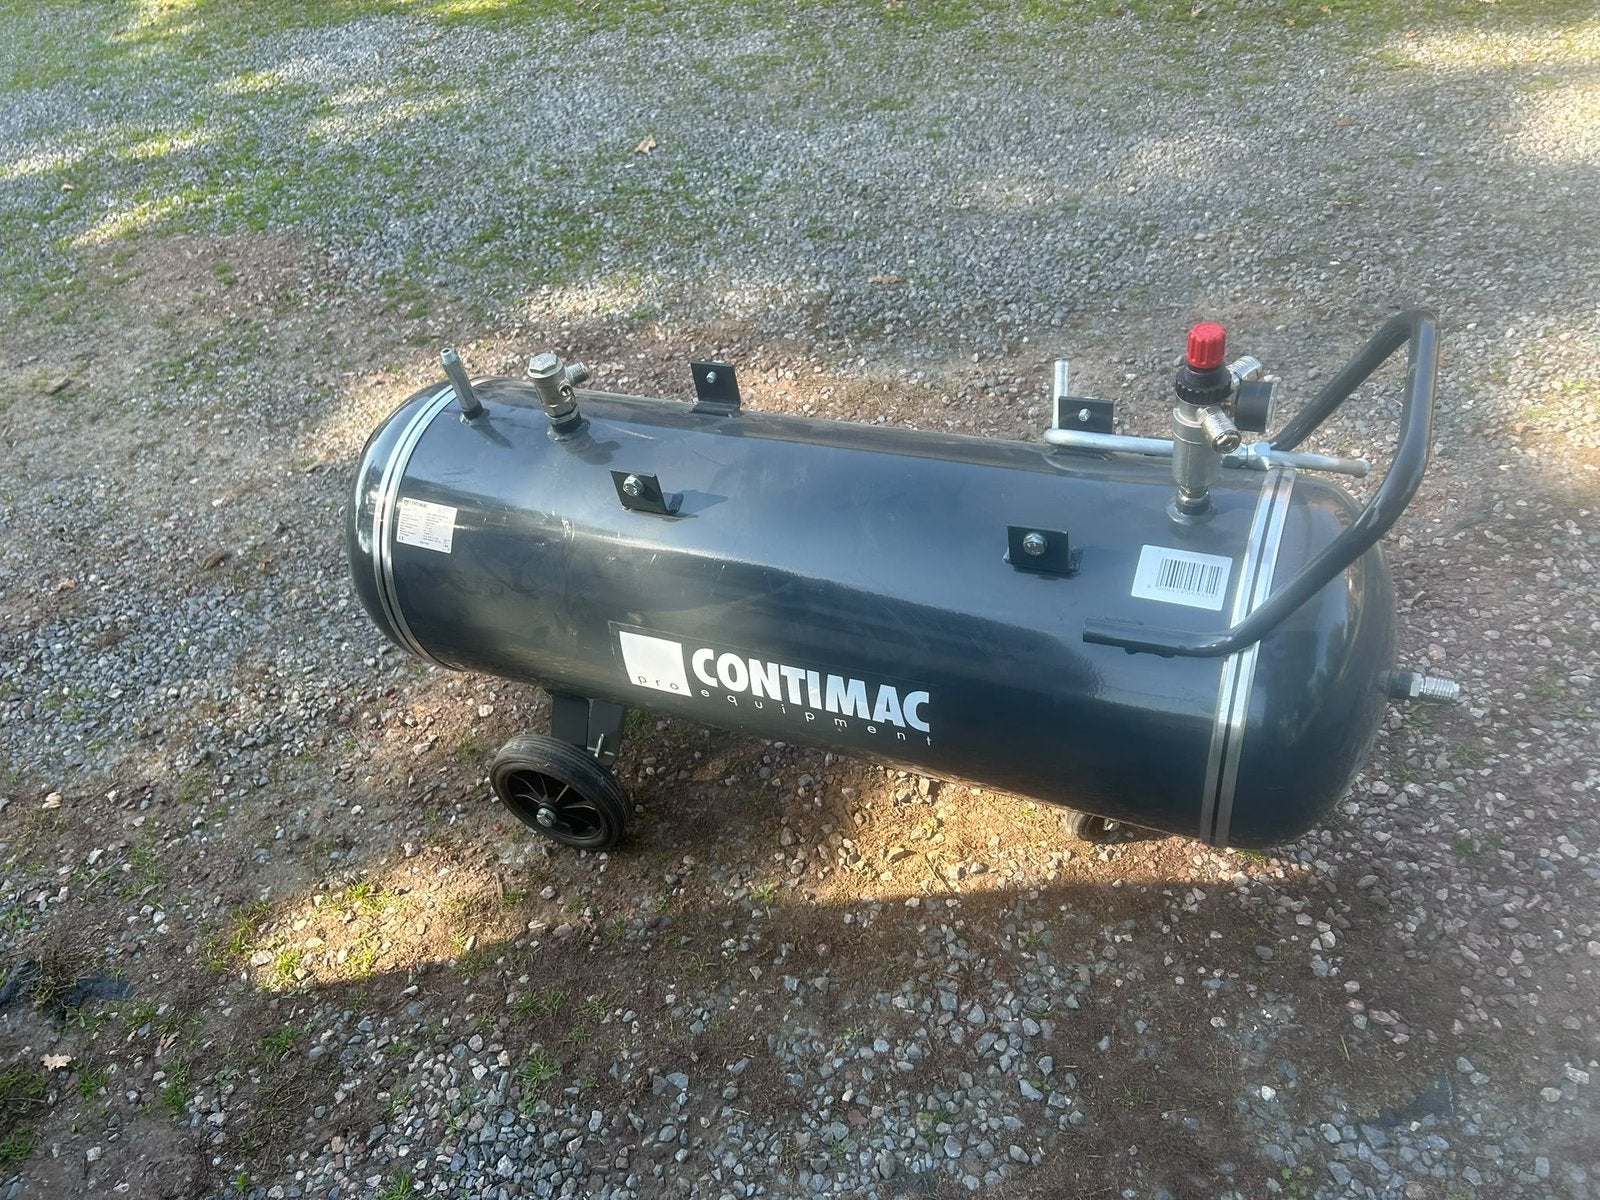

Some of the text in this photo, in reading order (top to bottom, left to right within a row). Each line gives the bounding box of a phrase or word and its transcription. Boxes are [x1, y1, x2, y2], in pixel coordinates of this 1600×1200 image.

[638, 675, 931, 746] pro equipment
[692, 648, 930, 732] CONTIMAC
